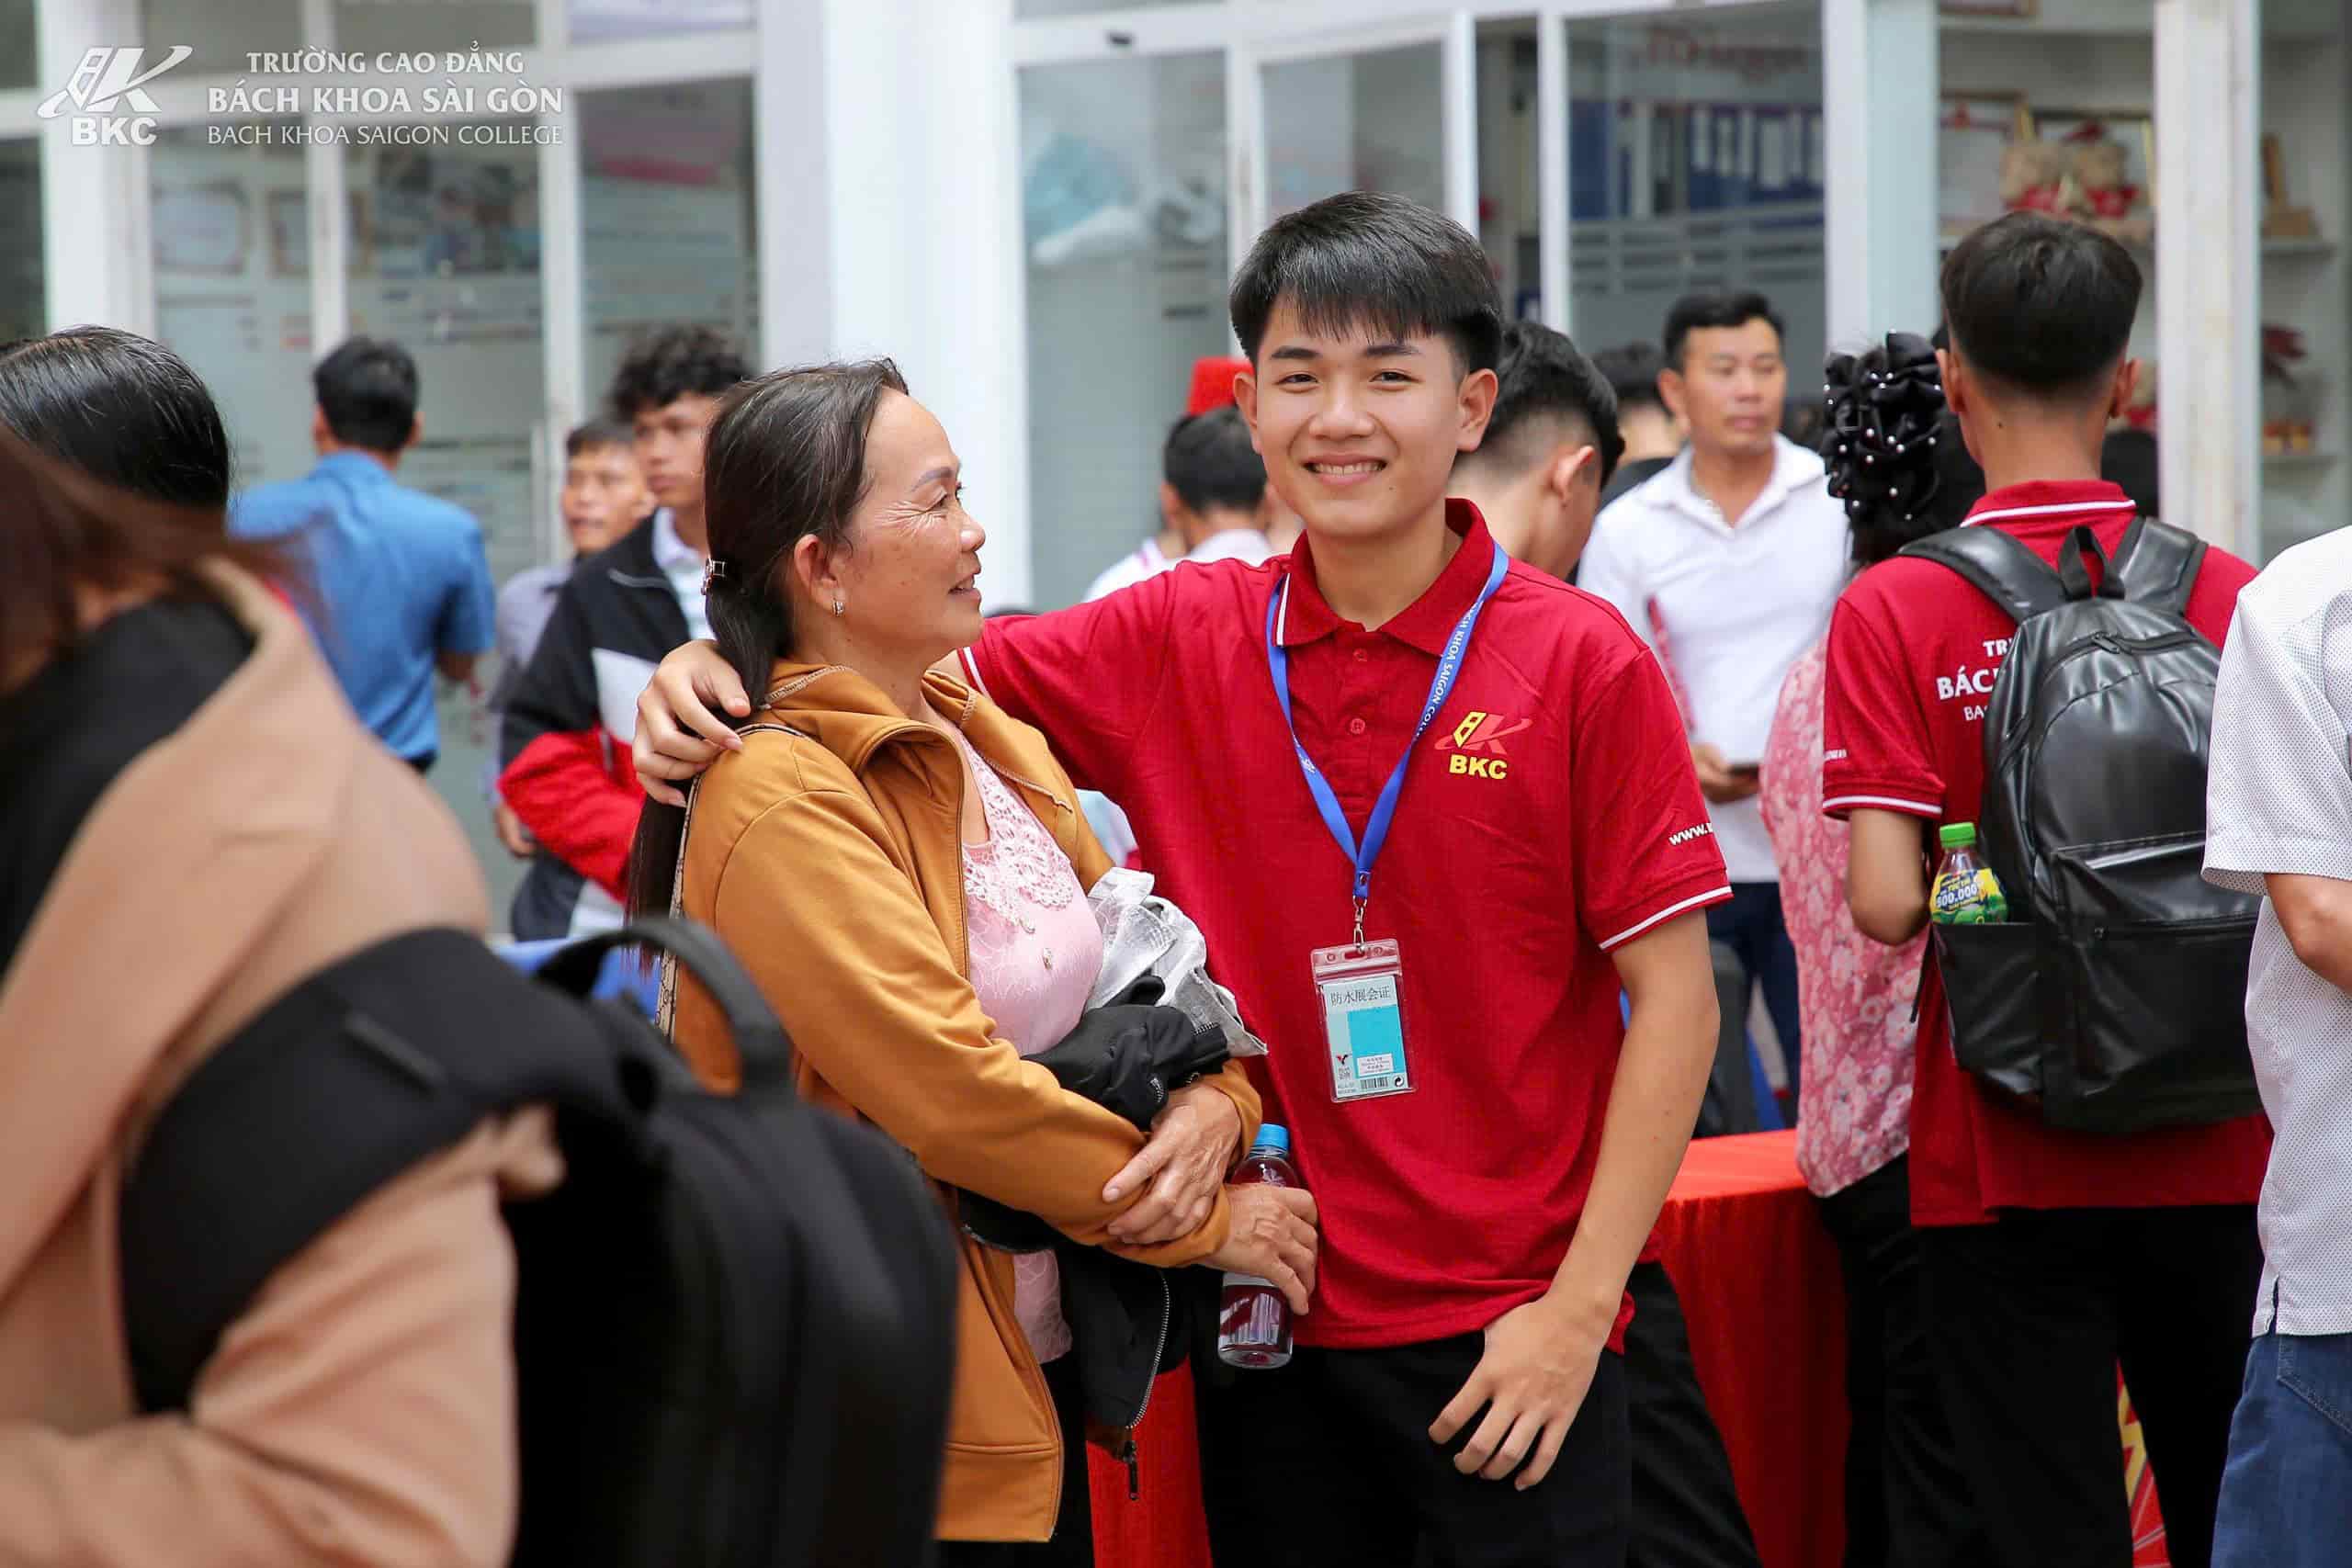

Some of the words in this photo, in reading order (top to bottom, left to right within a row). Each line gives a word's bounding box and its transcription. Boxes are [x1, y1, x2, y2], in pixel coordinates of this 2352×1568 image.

[1445, 631, 1465, 661] KHOA
[1983, 637, 2013, 658] TR
[1431, 663, 1454, 705] SAIGON
[1936, 664, 2000, 701] BÁC
[1963, 705, 1987, 721] BA
[1449, 753, 1508, 780] BKC
[1329, 985, 1391, 1006] 防水展会证
